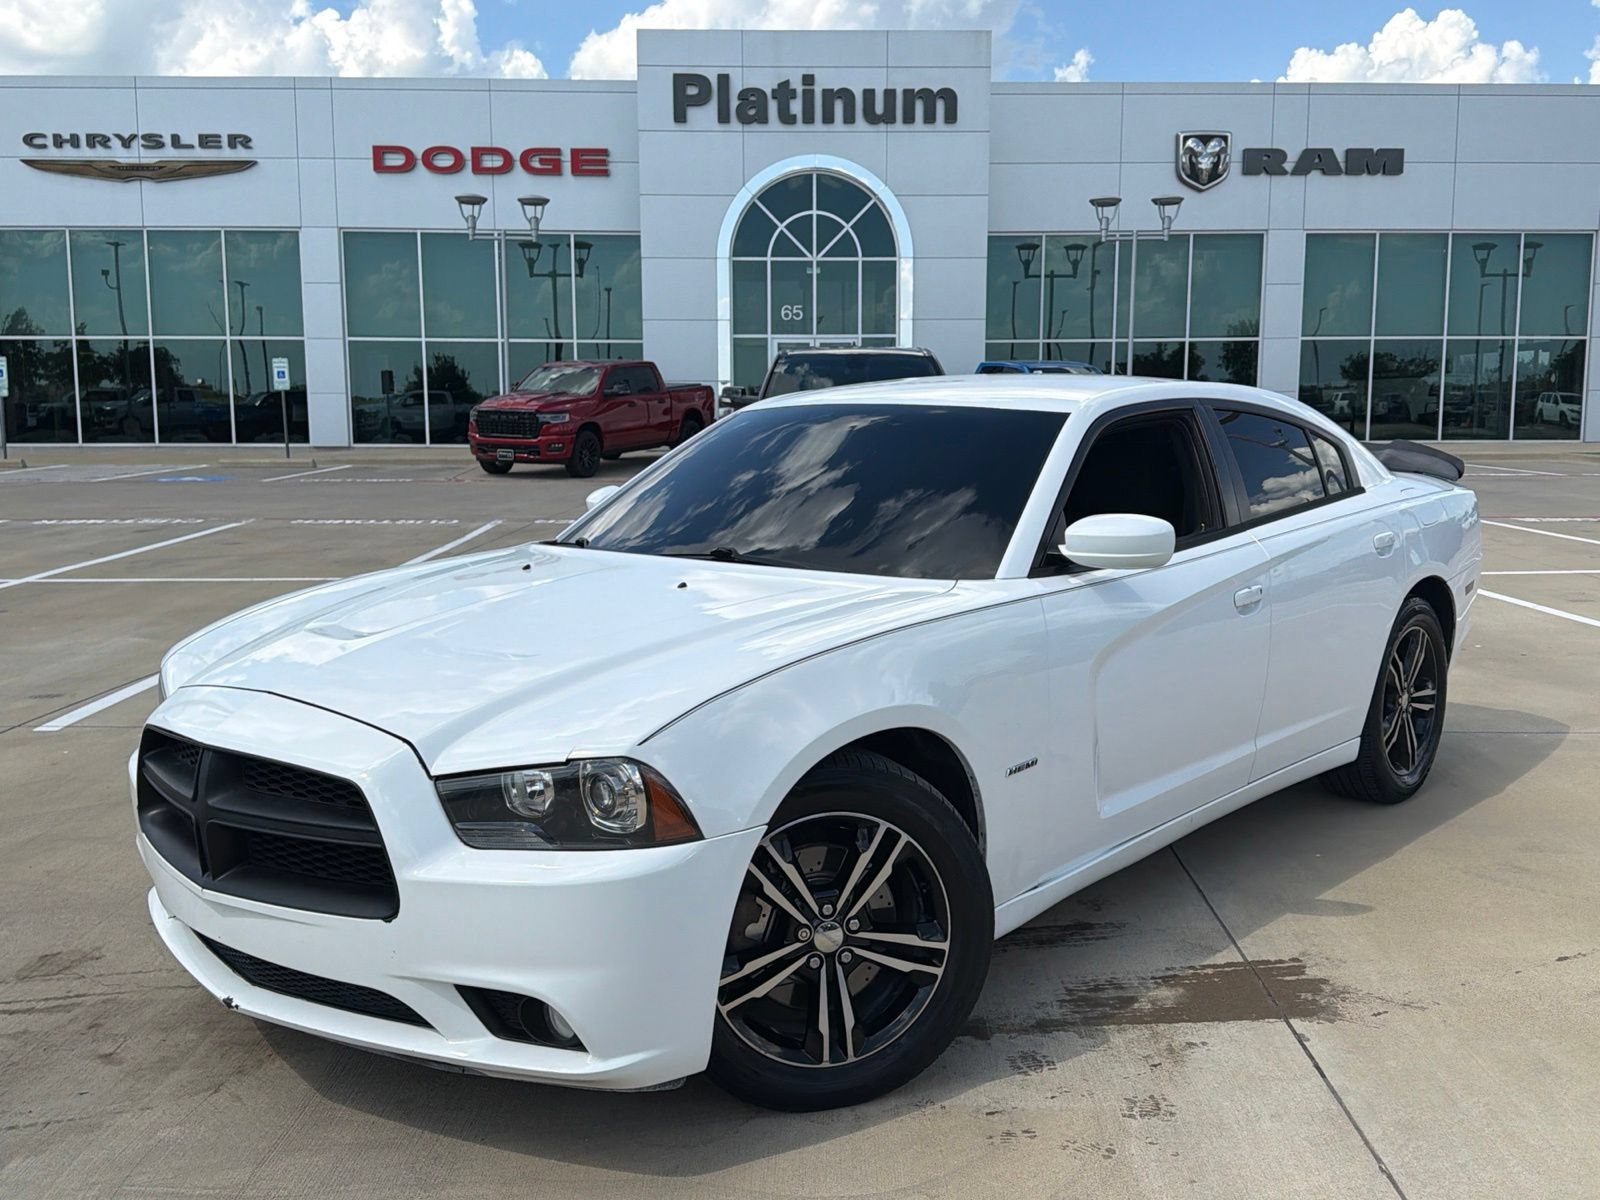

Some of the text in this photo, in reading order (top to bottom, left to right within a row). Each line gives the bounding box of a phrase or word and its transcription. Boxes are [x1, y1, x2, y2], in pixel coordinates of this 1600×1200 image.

[672, 73, 959, 125] Platinum
[22, 132, 254, 150] CHRYSLER
[372, 145, 610, 176] DODGE
[1242, 148, 1405, 176] RAM
[780, 305, 804, 321] 65
